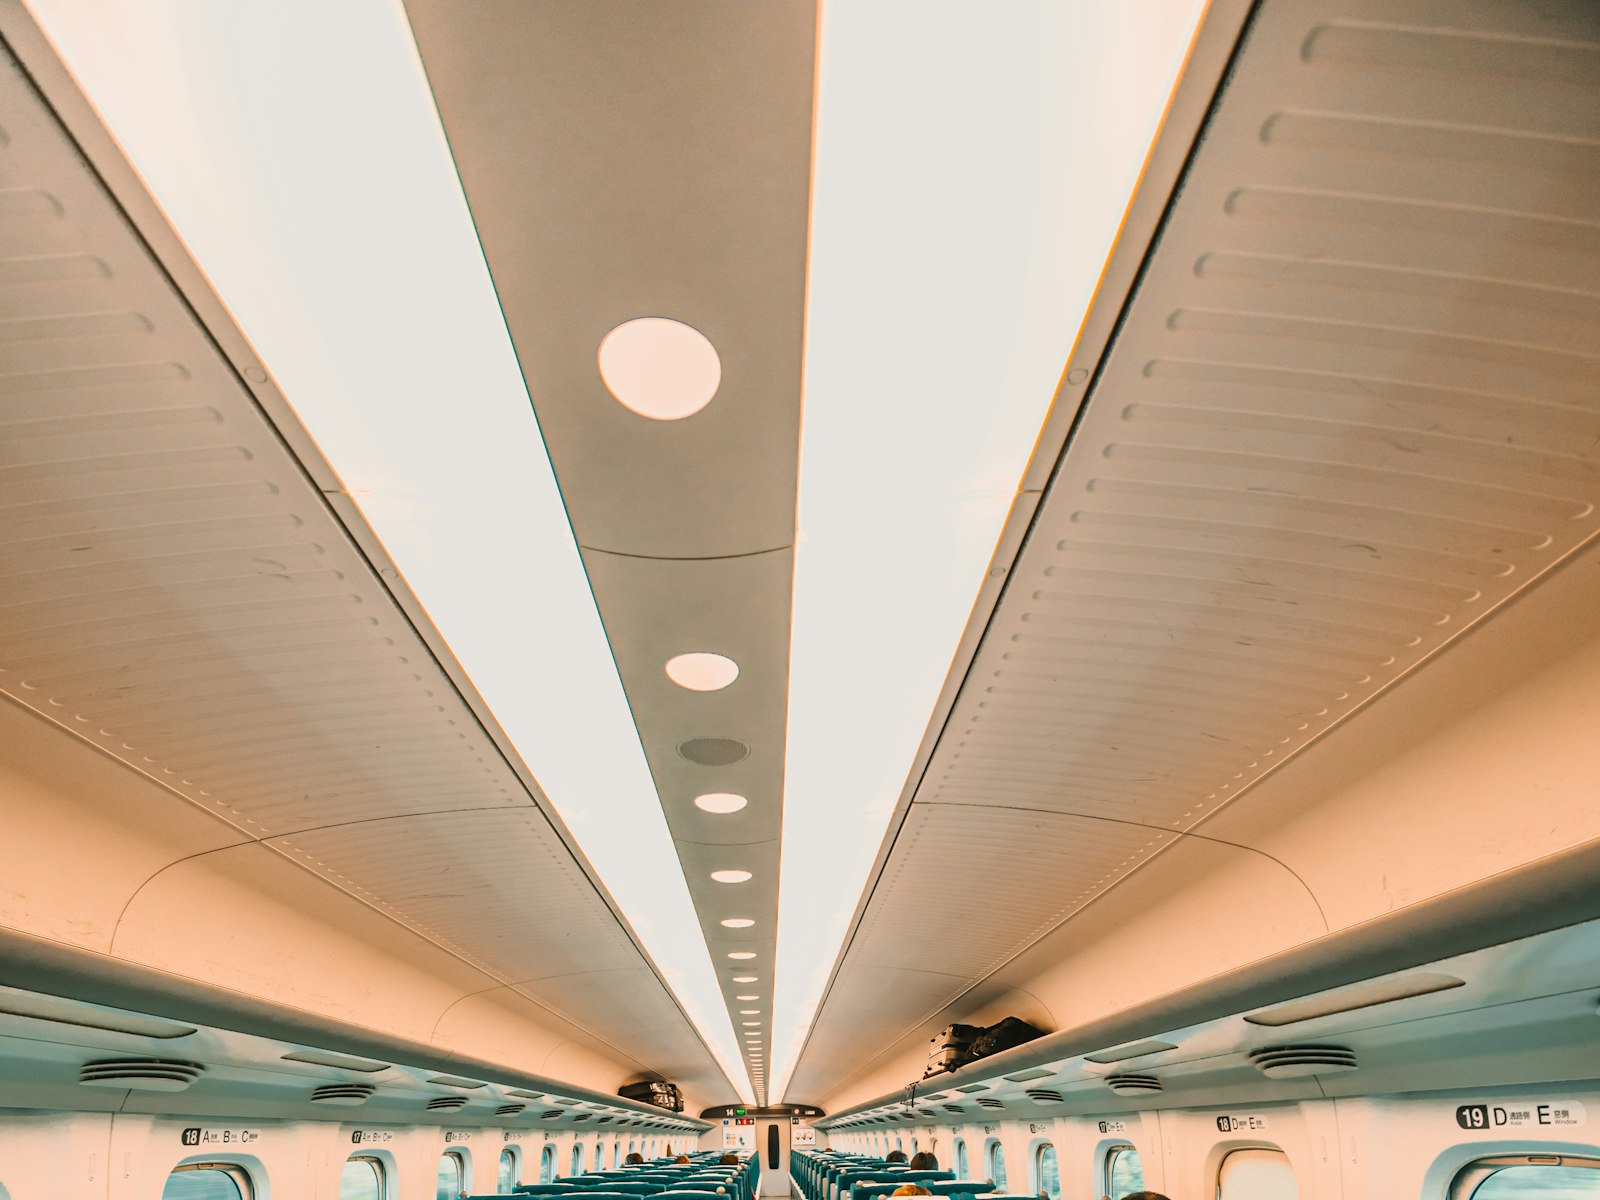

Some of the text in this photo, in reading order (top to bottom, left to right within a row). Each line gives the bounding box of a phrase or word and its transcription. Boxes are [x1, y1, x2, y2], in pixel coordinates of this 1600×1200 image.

[1462, 1108, 1483, 1127] 19
[1493, 1108, 1507, 1125] D
[1509, 1112, 1530, 1120] 通路側
[1537, 1105, 1551, 1124] E
[1219, 1118, 1229, 1131] 18
[1232, 1118, 1238, 1129] D
[1249, 1117, 1256, 1129] E
[185, 1130, 198, 1144] 18
[202, 1131, 209, 1143] A
[223, 1131, 230, 1143] B
[242, 1131, 248, 1143] C
[354, 1132, 360, 1142] 17
